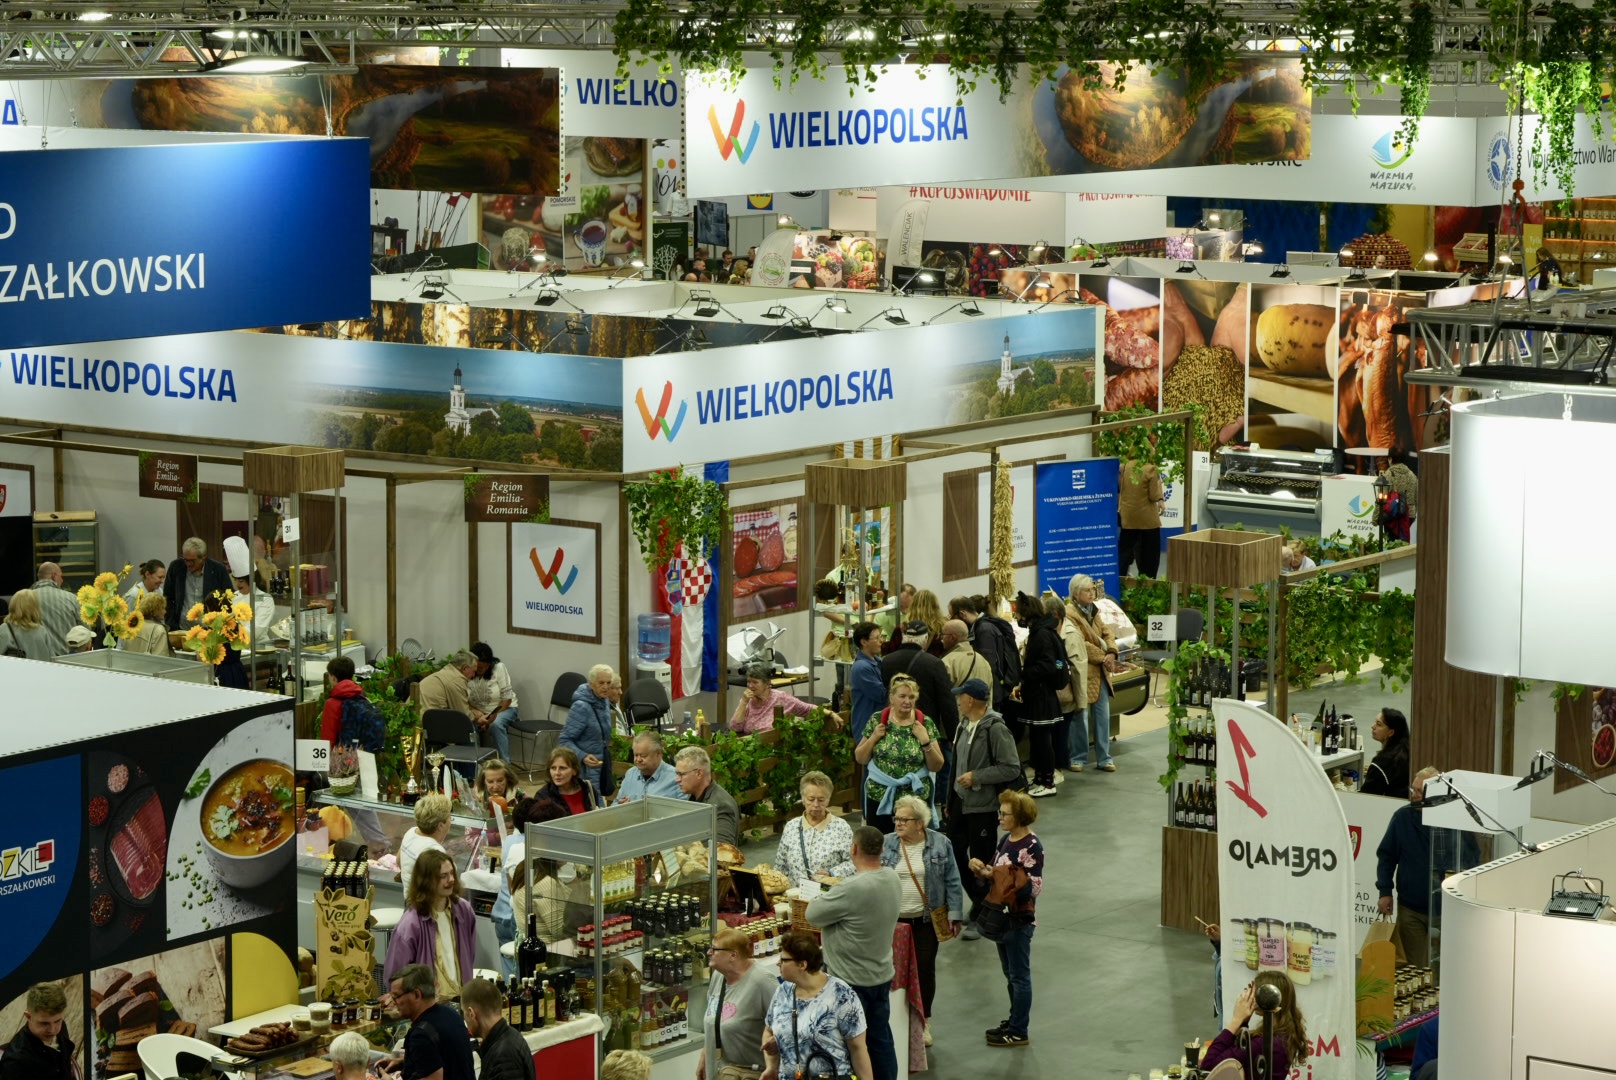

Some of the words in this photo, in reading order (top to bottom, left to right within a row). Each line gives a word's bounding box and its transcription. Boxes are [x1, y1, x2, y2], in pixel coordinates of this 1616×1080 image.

[769, 106, 969, 149] WIELKOPOLSKA
[1370, 171, 1414, 180] WARMIA
[10, 352, 237, 403] WIELKOPOLSKA
[696, 367, 894, 425] WIELKOPOLSKA
[157, 459, 180, 471] Region
[156, 470, 181, 482] Emilia-
[153, 481, 184, 494] Romania
[491, 481, 524, 494] Region
[490, 492, 525, 504] Emilia-
[486, 503, 529, 516] Romania
[525, 600, 584, 616] WIELKOPOLSKA
[1151, 621, 1163, 631] 32
[312, 748, 327, 759] 36
